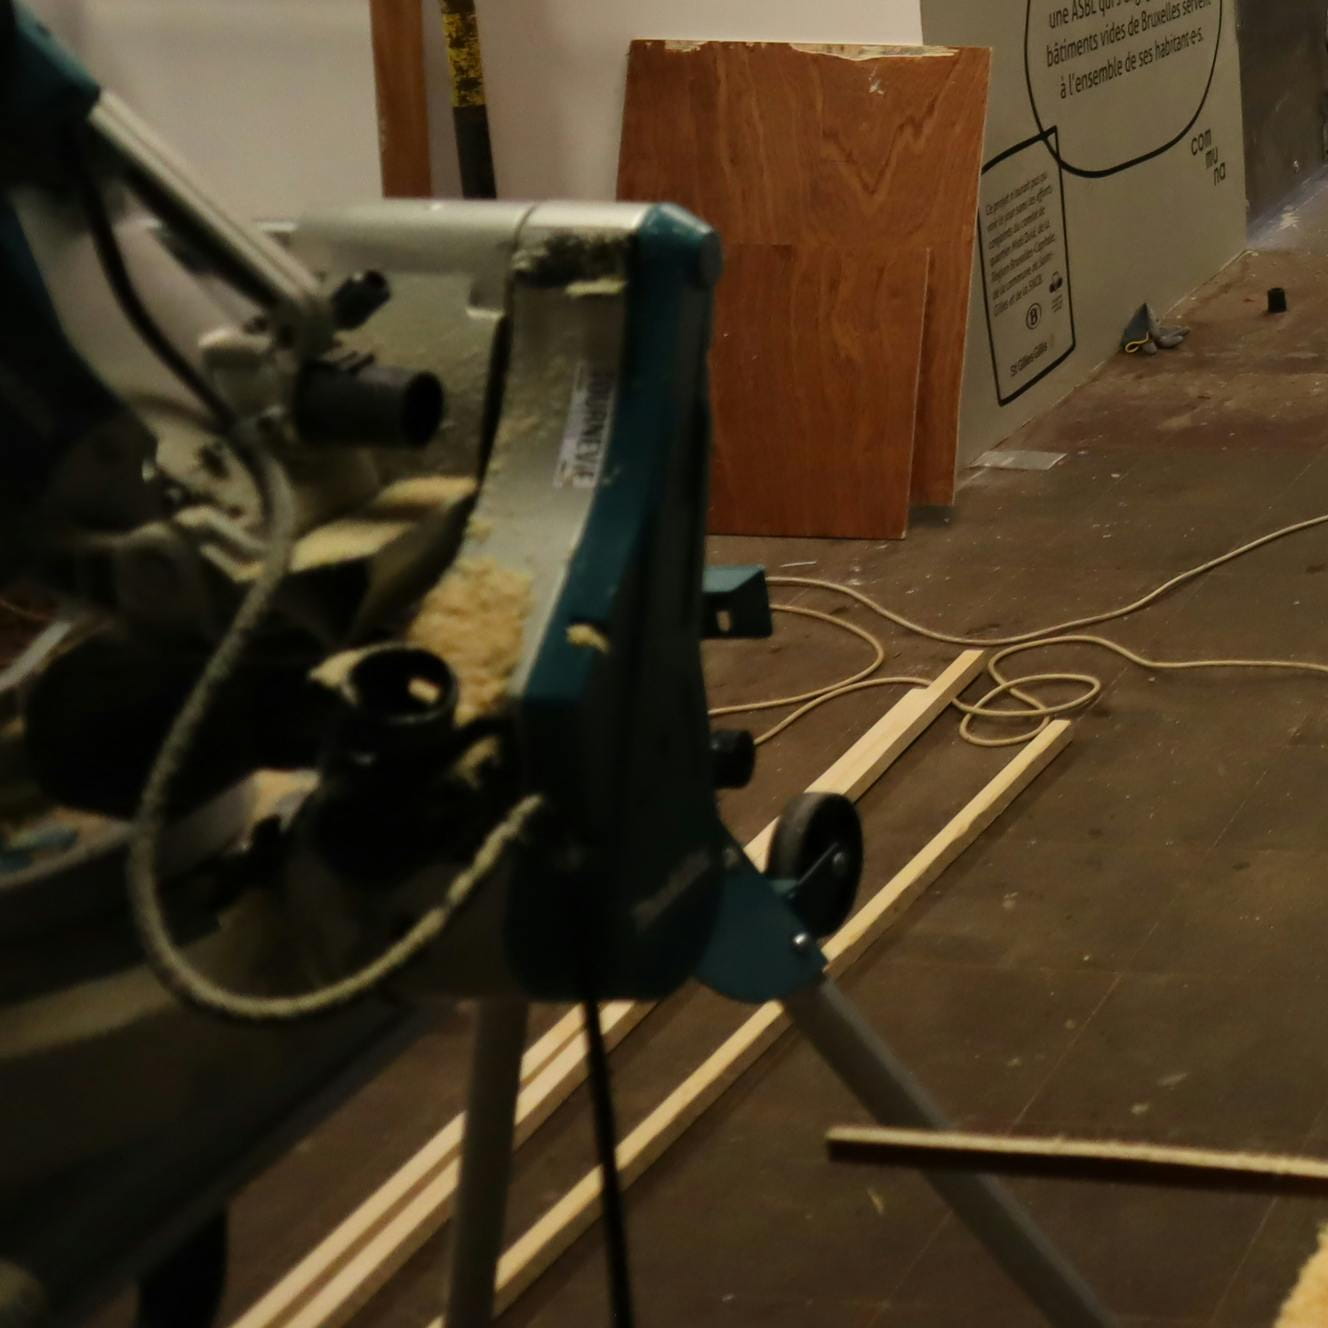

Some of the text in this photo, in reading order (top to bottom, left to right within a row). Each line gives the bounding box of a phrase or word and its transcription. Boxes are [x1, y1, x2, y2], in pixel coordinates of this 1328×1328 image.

[1046, 33, 1099, 68] bâtiments
[1100, 22, 1126, 47] vides
[1127, 15, 1140, 37] de
[1141, 2, 1181, 32] Bruxelles
[1049, 7, 1069, 29] une
[1060, 74, 1068, 99] à
[1125, 51, 1137, 74] de
[1138, 47, 1153, 68] ses
